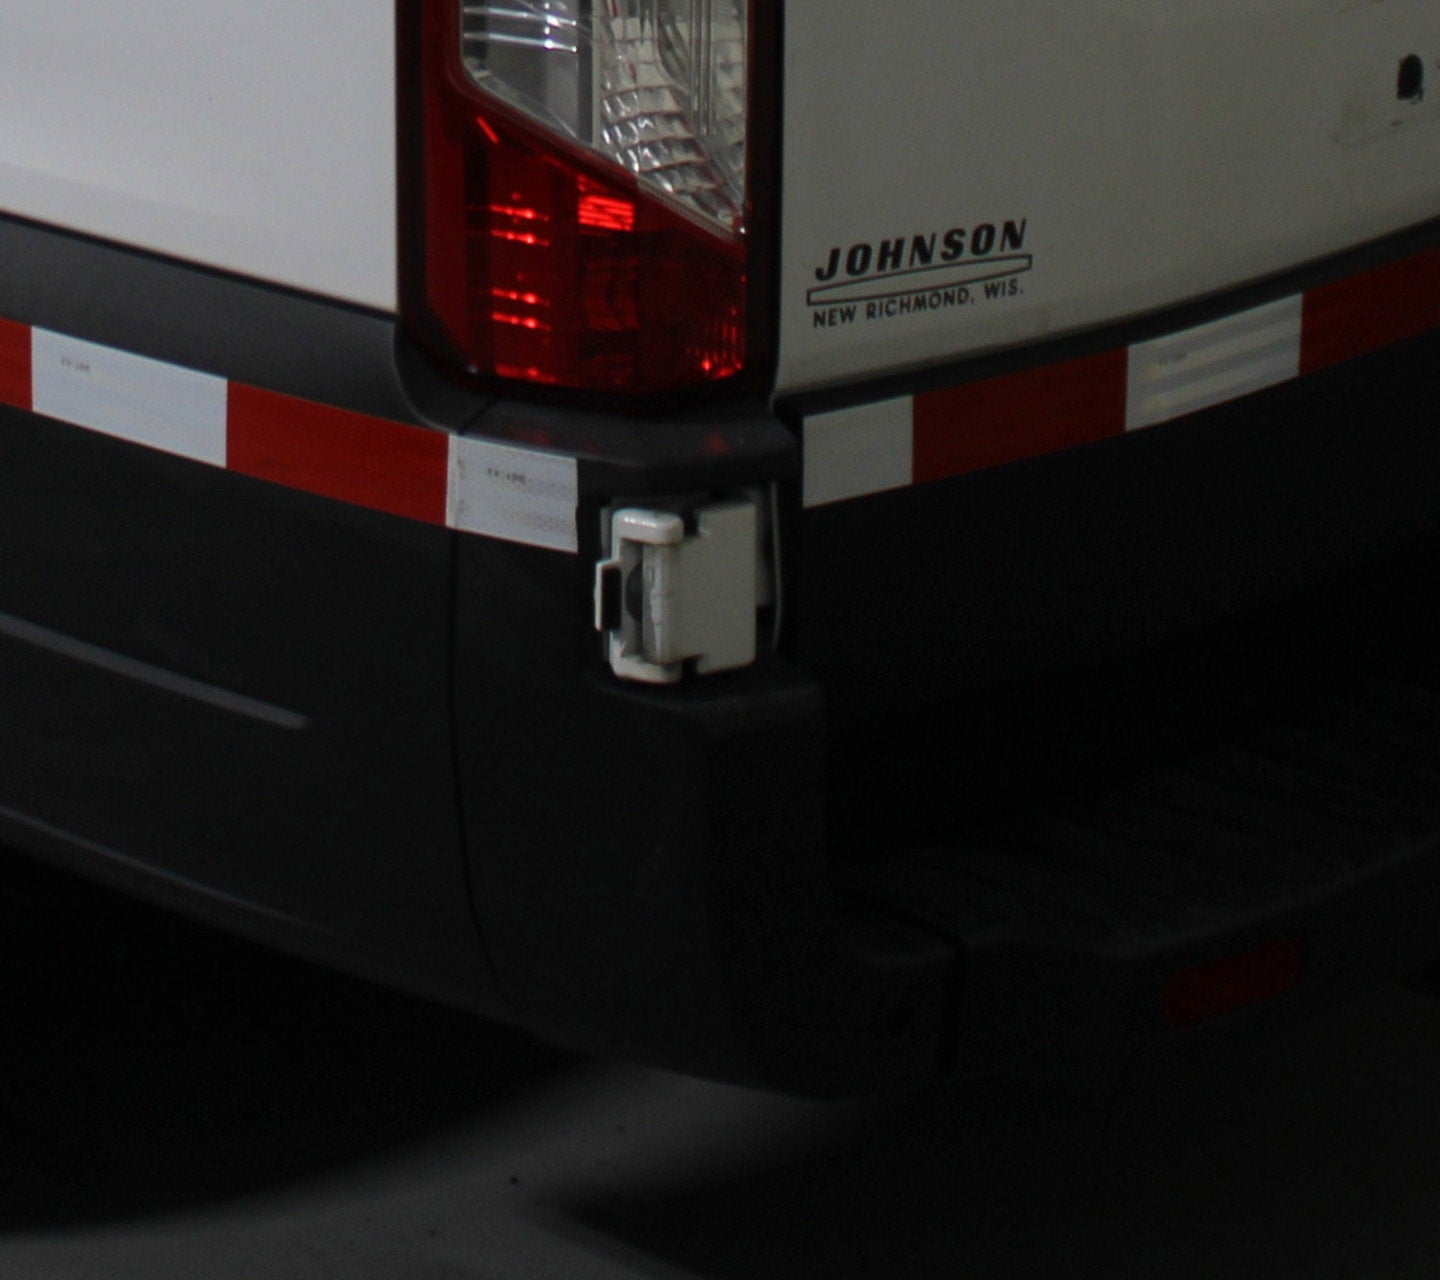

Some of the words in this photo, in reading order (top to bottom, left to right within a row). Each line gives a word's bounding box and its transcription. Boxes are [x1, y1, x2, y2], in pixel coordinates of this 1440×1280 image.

[815, 218, 1027, 281] JOHNSON
[813, 306, 856, 328] NEW
[984, 279, 1023, 300] WIS.
